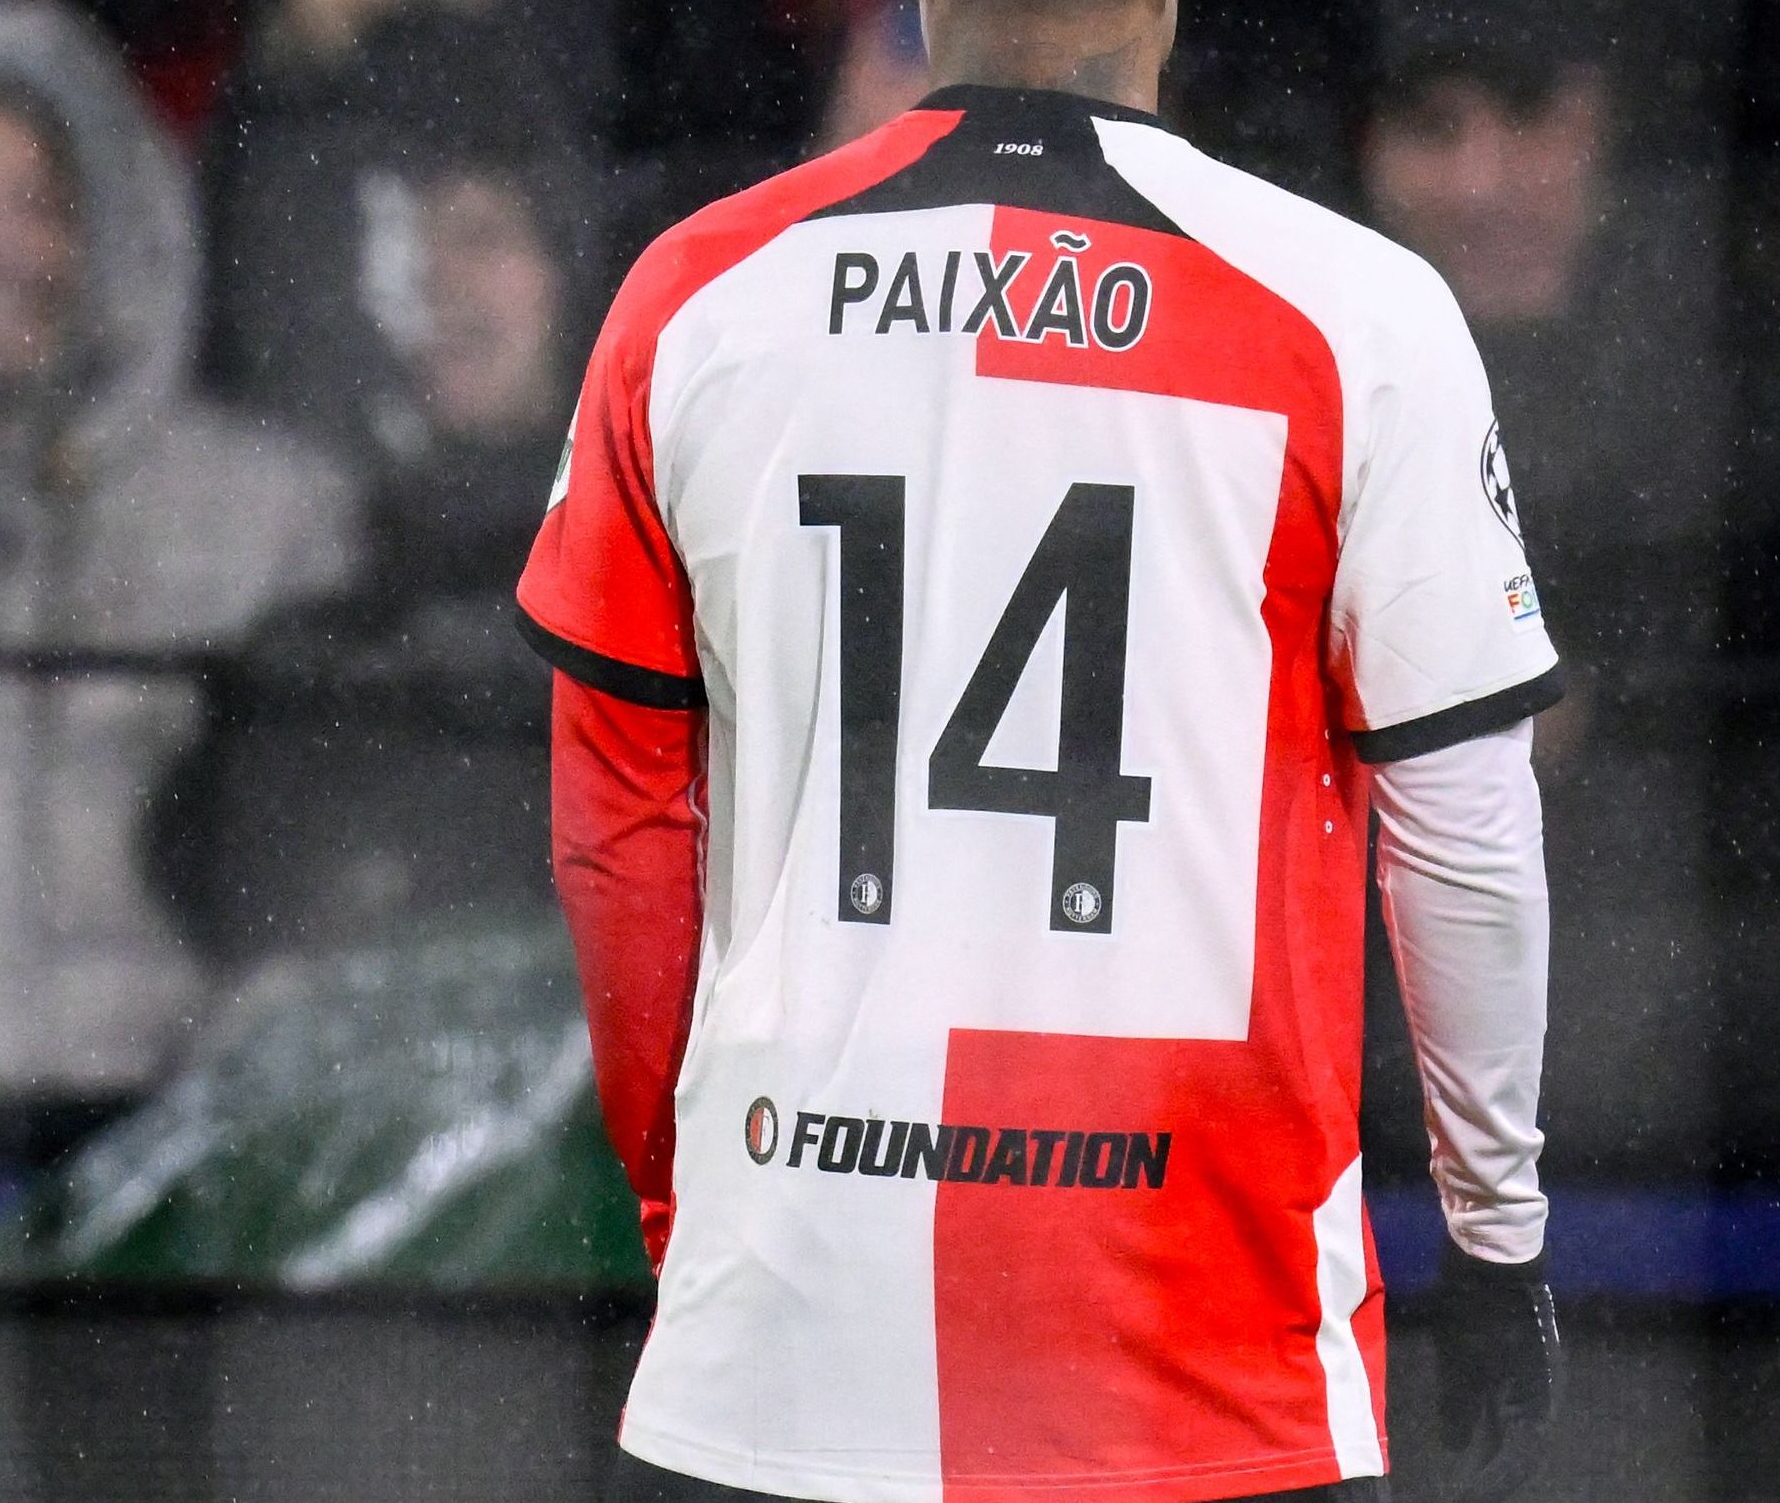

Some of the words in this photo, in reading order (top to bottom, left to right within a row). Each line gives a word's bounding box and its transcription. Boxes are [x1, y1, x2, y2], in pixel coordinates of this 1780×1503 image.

[992, 142, 1044, 157] 1908
[827, 230, 1151, 352] PAIXÃO
[797, 474, 1152, 934] 14
[785, 1110, 1172, 1190] FOUNDATION
